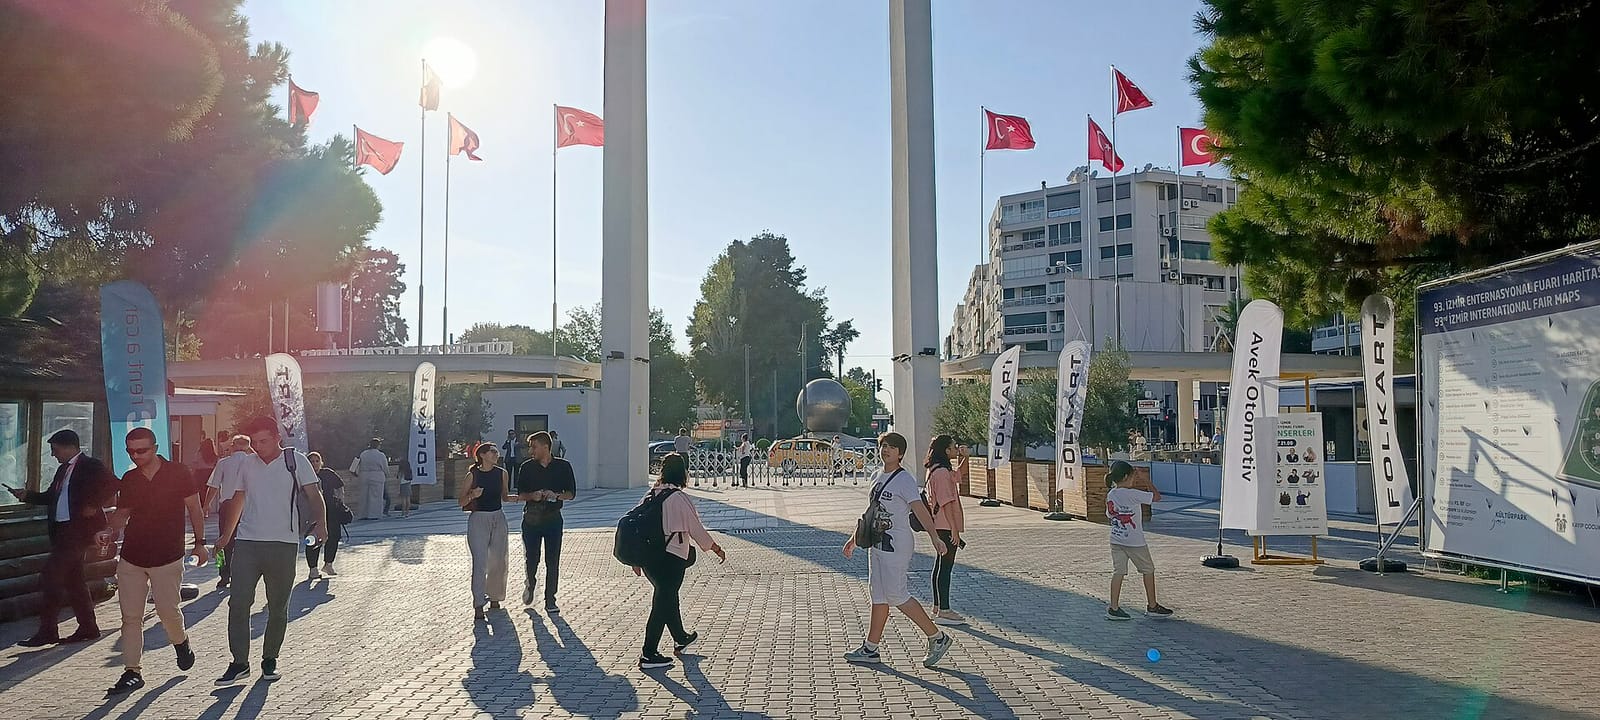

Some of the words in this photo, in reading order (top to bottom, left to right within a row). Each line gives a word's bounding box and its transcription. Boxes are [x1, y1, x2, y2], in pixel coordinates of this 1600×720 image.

[1433, 303, 1446, 313] 93.
[1445, 295, 1466, 311] İZMİR
[1466, 283, 1533, 305] ENTERNASYONAL
[1533, 276, 1561, 293] FUARI
[1448, 310, 1469, 325] İZMİR
[1469, 301, 1532, 321] INTERNATIONAL
[1533, 295, 1553, 310] FAIR
[1554, 289, 1581, 305] MAPS
[1247, 331, 1263, 380] Avek
[416, 374, 429, 477] FOLKART
[1277, 428, 1315, 437] NSERLERİ
[1372, 314, 1401, 508] FOLKART
[1241, 386, 1260, 482] Otomotiv
[1495, 510, 1528, 521] KÜLTÜRPARK
